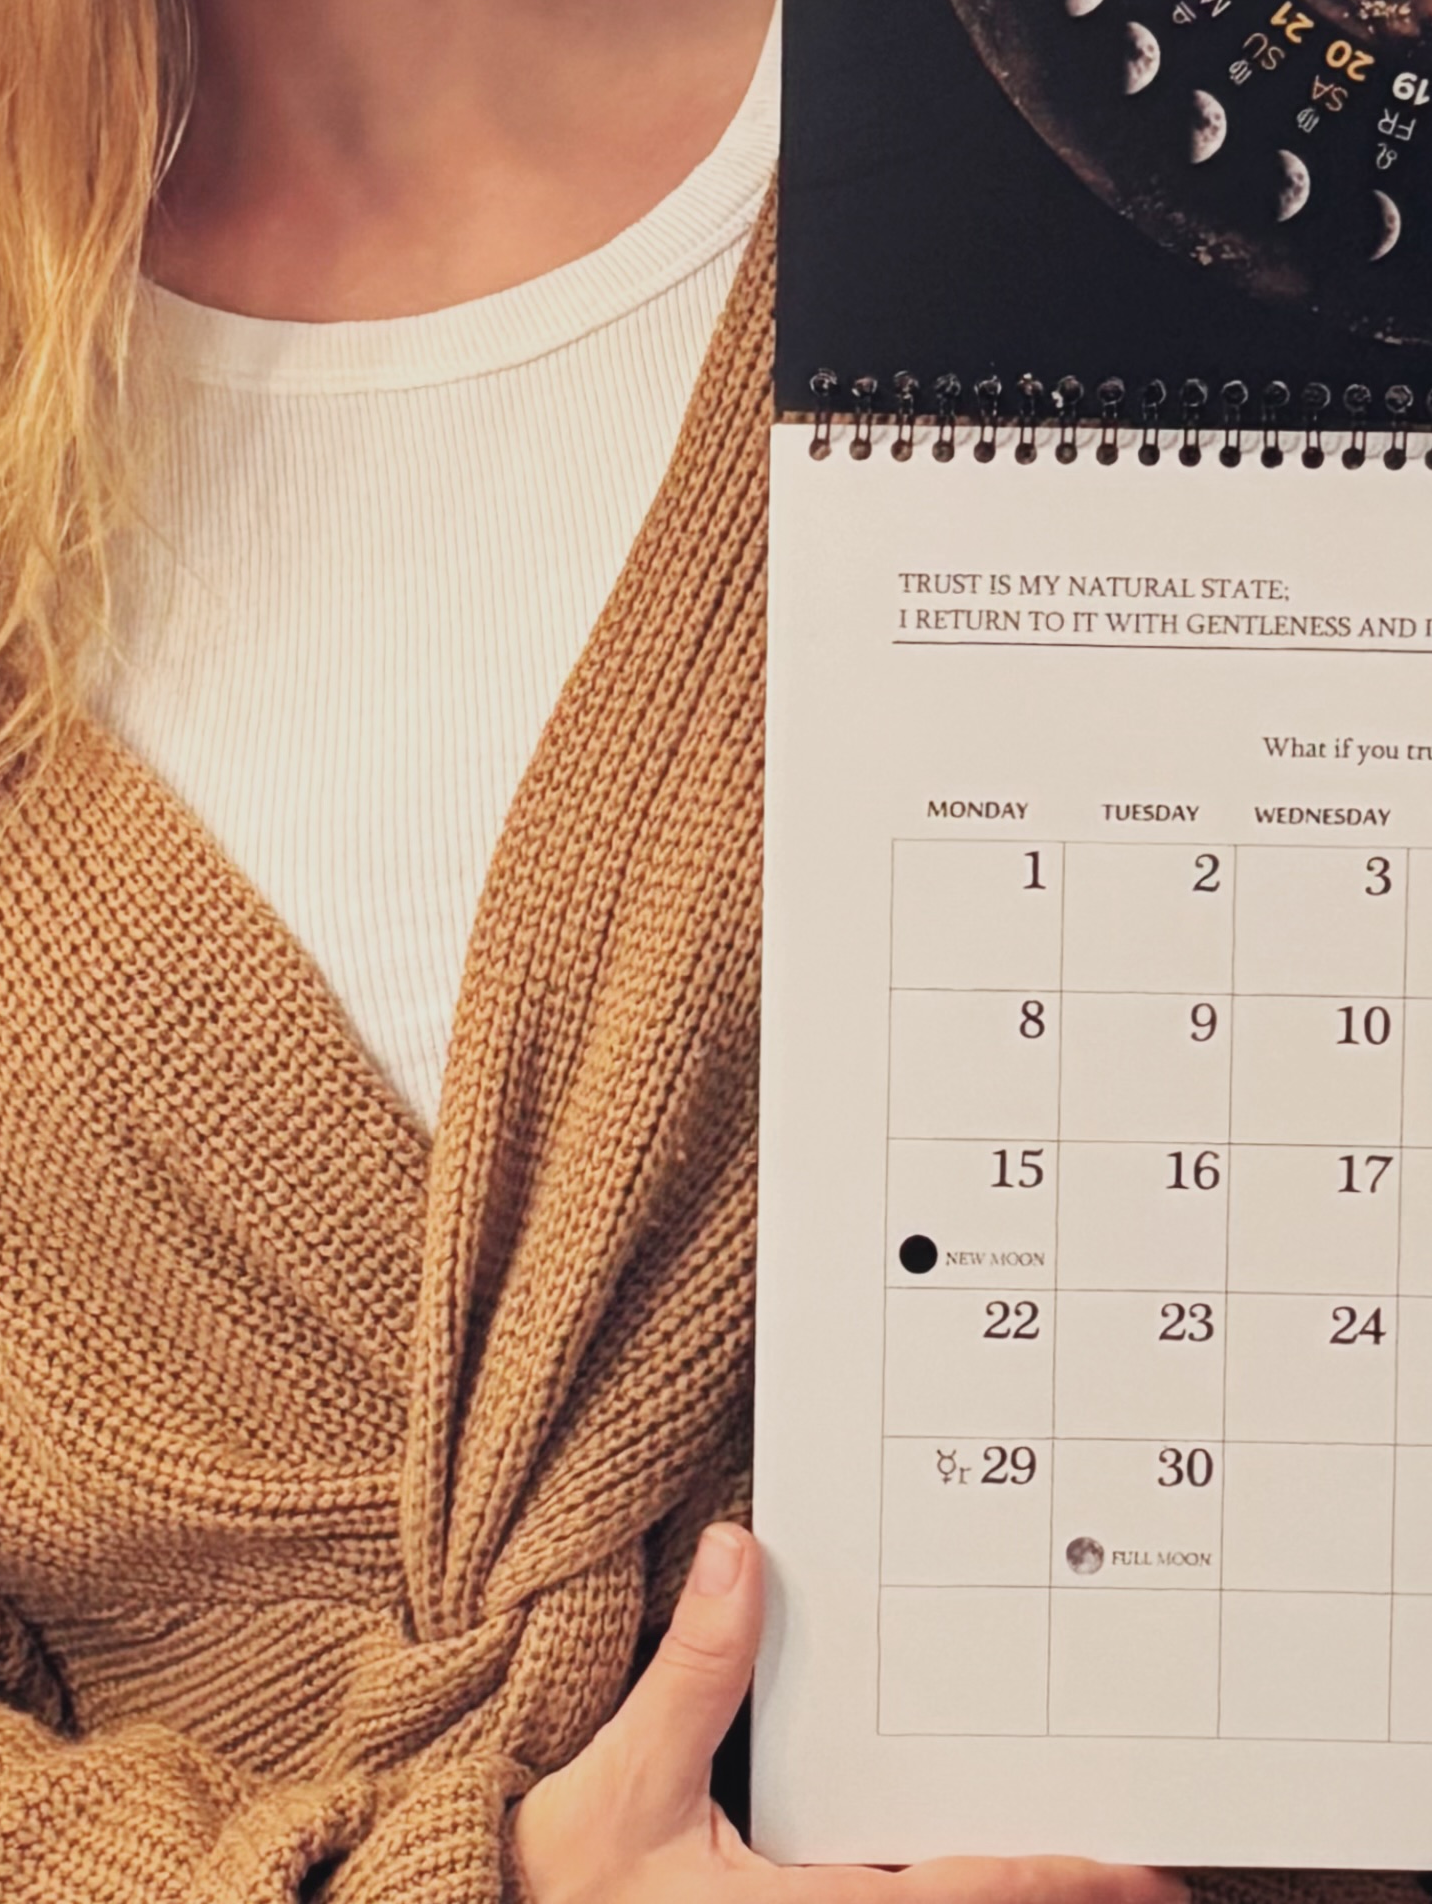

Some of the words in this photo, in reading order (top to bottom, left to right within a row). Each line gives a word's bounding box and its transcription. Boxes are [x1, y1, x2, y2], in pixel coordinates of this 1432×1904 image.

[1270, 0, 1315, 44] 21
[1242, 32, 1286, 71] SU
[1325, 40, 1375, 81] 20
[1311, 74, 1349, 112] SA
[1391, 71, 1430, 106] 19
[1377, 108, 1417, 142] FR
[897, 572, 983, 595] TRUST
[989, 574, 1012, 596] IS
[1019, 574, 1061, 596] MY
[1068, 575, 1196, 599] NATURAL
[1201, 577, 1290, 602] STATE;
[899, 608, 907, 629] I
[915, 608, 1021, 631] RETURN
[1027, 610, 1065, 633] TO
[1072, 611, 1099, 633] IT
[1104, 612, 1178, 635] WITH
[1186, 613, 1352, 638] GENTLENESS
[1357, 617, 1417, 639] AND
[1262, 736, 1327, 759] What
[1334, 736, 1354, 759] if
[1356, 744, 1399, 766] you
[927, 800, 1028, 820] MONDAY
[1102, 803, 1200, 822] TUESDAY
[1254, 806, 1391, 827] WEDNESDAY
[1023, 850, 1047, 890] 1
[1192, 853, 1221, 893] 2
[1365, 856, 1392, 897] 3
[1019, 999, 1046, 1039] 8
[1190, 1002, 1218, 1043] 9
[1336, 1005, 1391, 1046] 10
[991, 1148, 1044, 1189] 15
[1166, 1150, 1220, 1191] 16
[1338, 1154, 1394, 1194] 17
[945, 1251, 986, 1267] NEW
[990, 1251, 1045, 1267] MOON
[982, 1300, 1040, 1340] 22
[1158, 1302, 1215, 1343] 23
[1329, 1305, 1387, 1346] 24
[980, 1445, 1037, 1485] 29
[1157, 1447, 1214, 1488] 30
[1111, 1550, 1152, 1566] FULL
[1157, 1551, 1212, 1567] MOON
